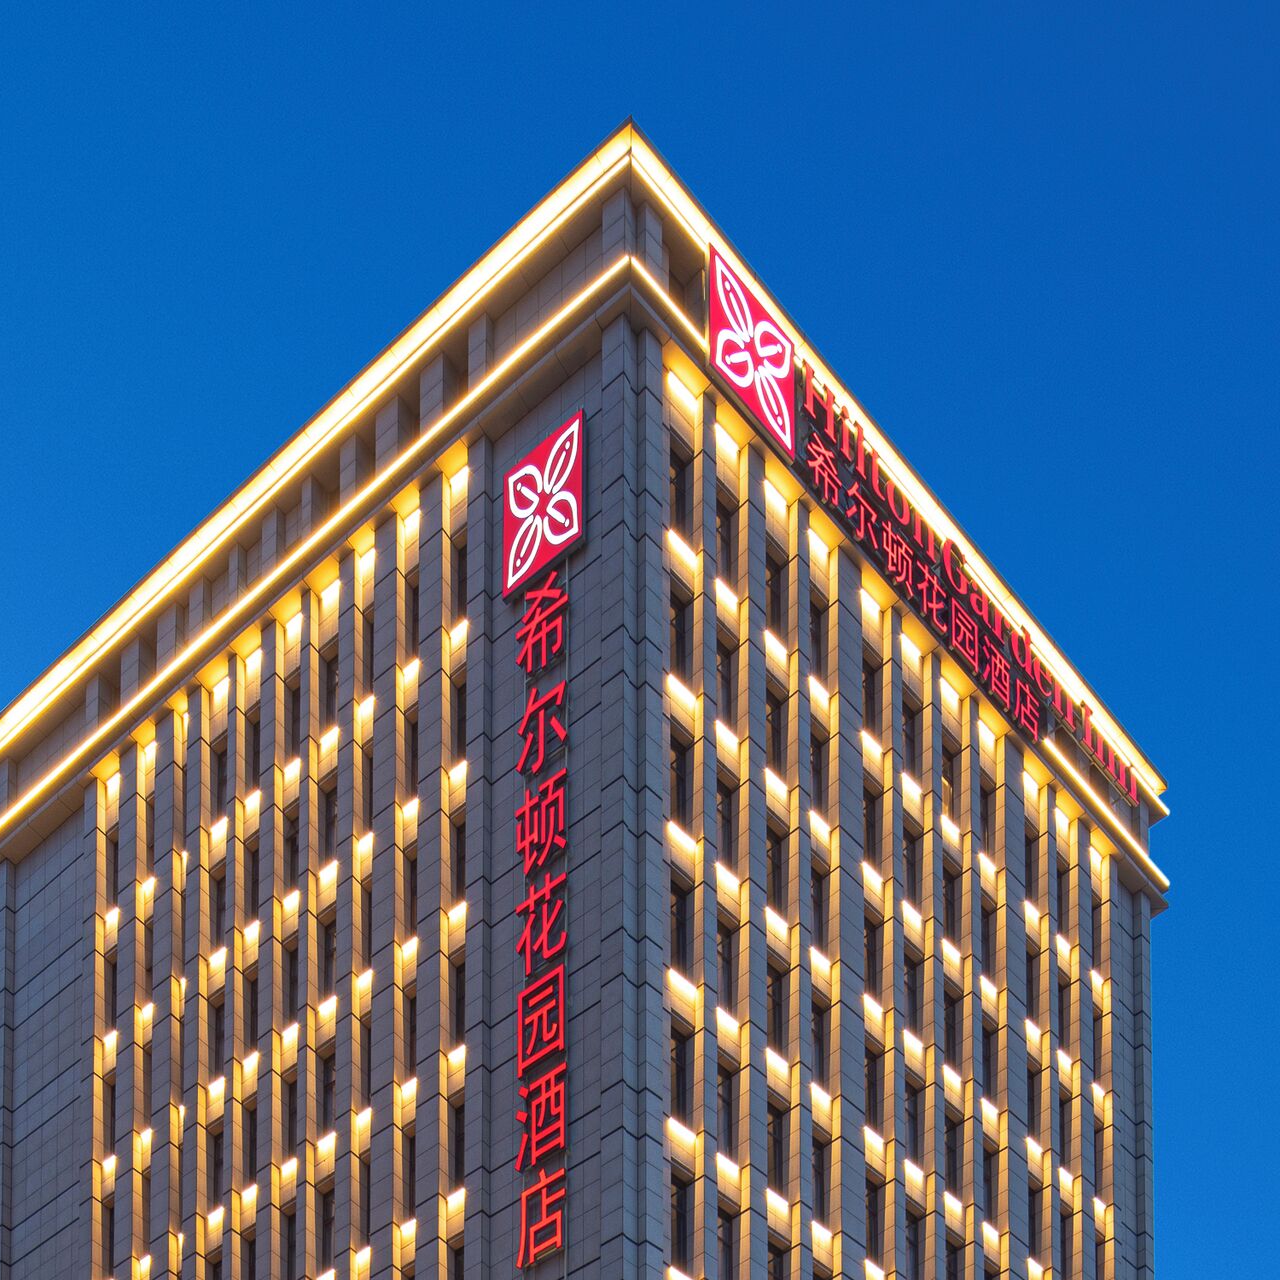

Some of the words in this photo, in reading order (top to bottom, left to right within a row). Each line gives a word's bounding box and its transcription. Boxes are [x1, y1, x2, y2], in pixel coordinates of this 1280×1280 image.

[803, 358, 936, 562] Hilton
[942, 537, 1076, 732] Garden
[1080, 700, 1140, 806] Inn
[807, 433, 1040, 741] 希尔顿花园酒店
[515, 570, 568, 1269] 希尔顿花园酒店
